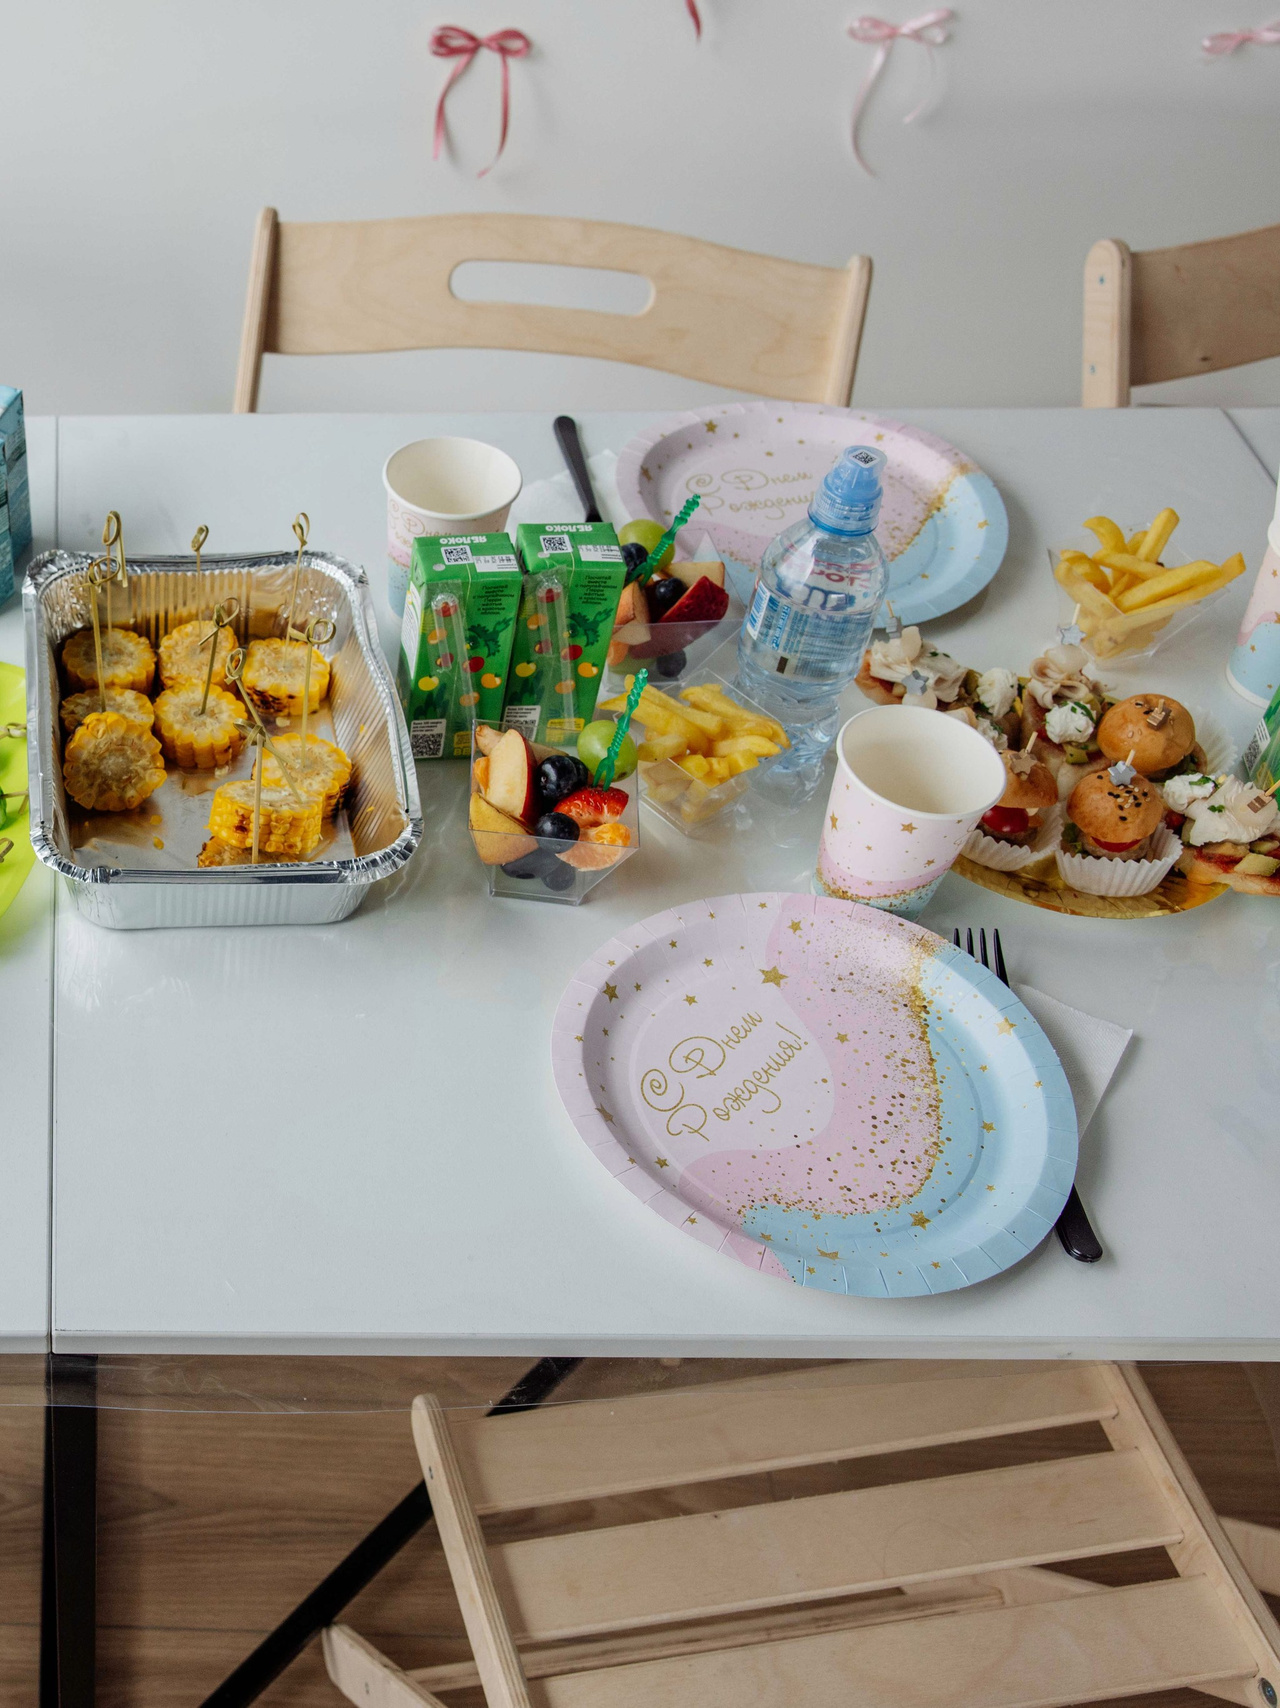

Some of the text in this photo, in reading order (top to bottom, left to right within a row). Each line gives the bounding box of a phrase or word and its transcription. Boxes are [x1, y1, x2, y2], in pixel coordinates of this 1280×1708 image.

[439, 536, 487, 545] ЯБЛОКО
[640, 1011, 763, 1112] С Днем
[666, 1021, 809, 1142] Рождения!
